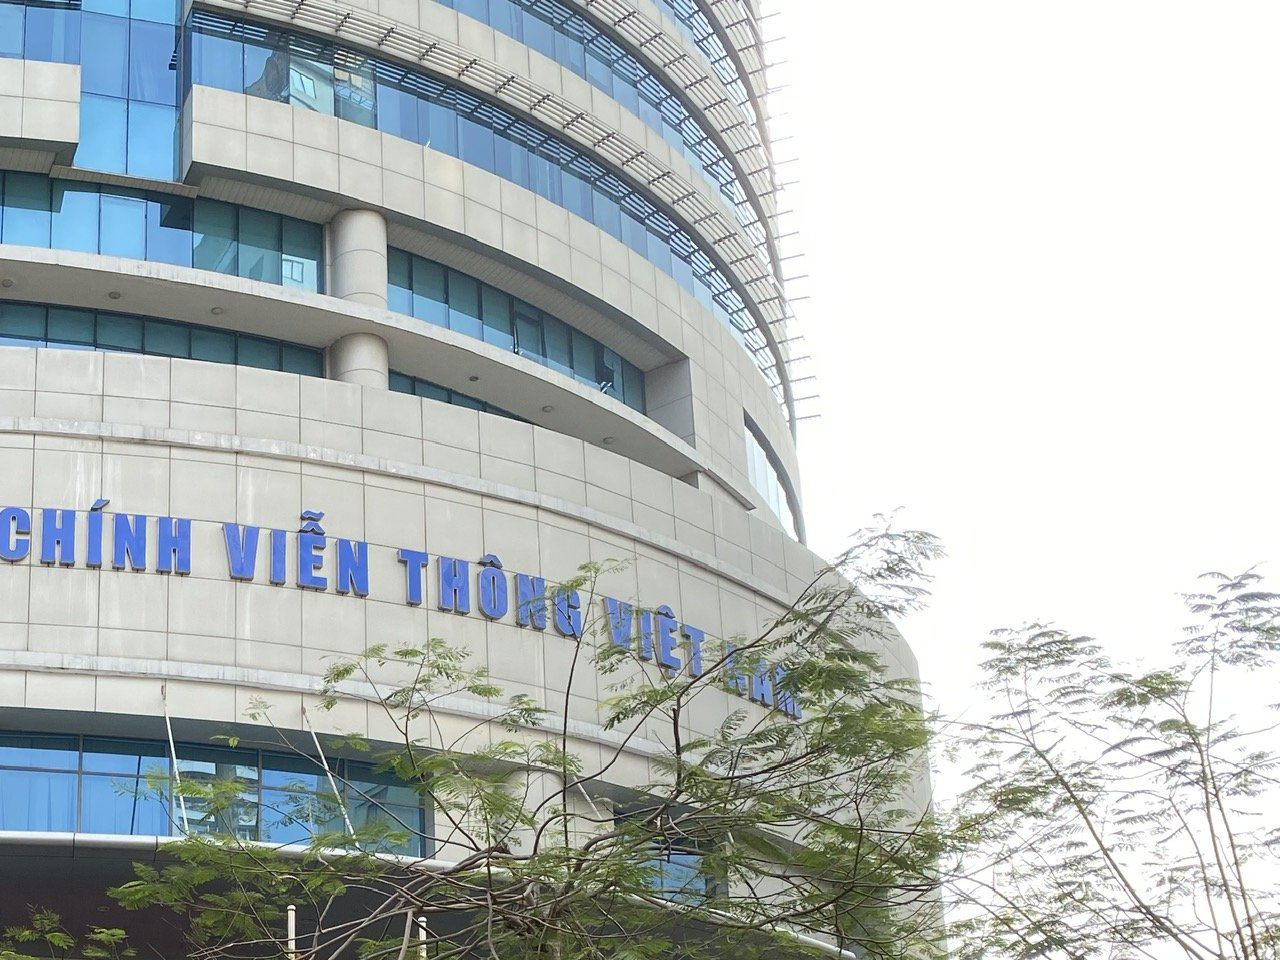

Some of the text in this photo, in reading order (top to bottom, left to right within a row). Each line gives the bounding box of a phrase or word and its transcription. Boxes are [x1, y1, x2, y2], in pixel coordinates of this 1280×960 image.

[222, 510, 369, 598] VIỄN
[396, 548, 582, 637] THÔNG
[602, 596, 706, 679] VIỆT
